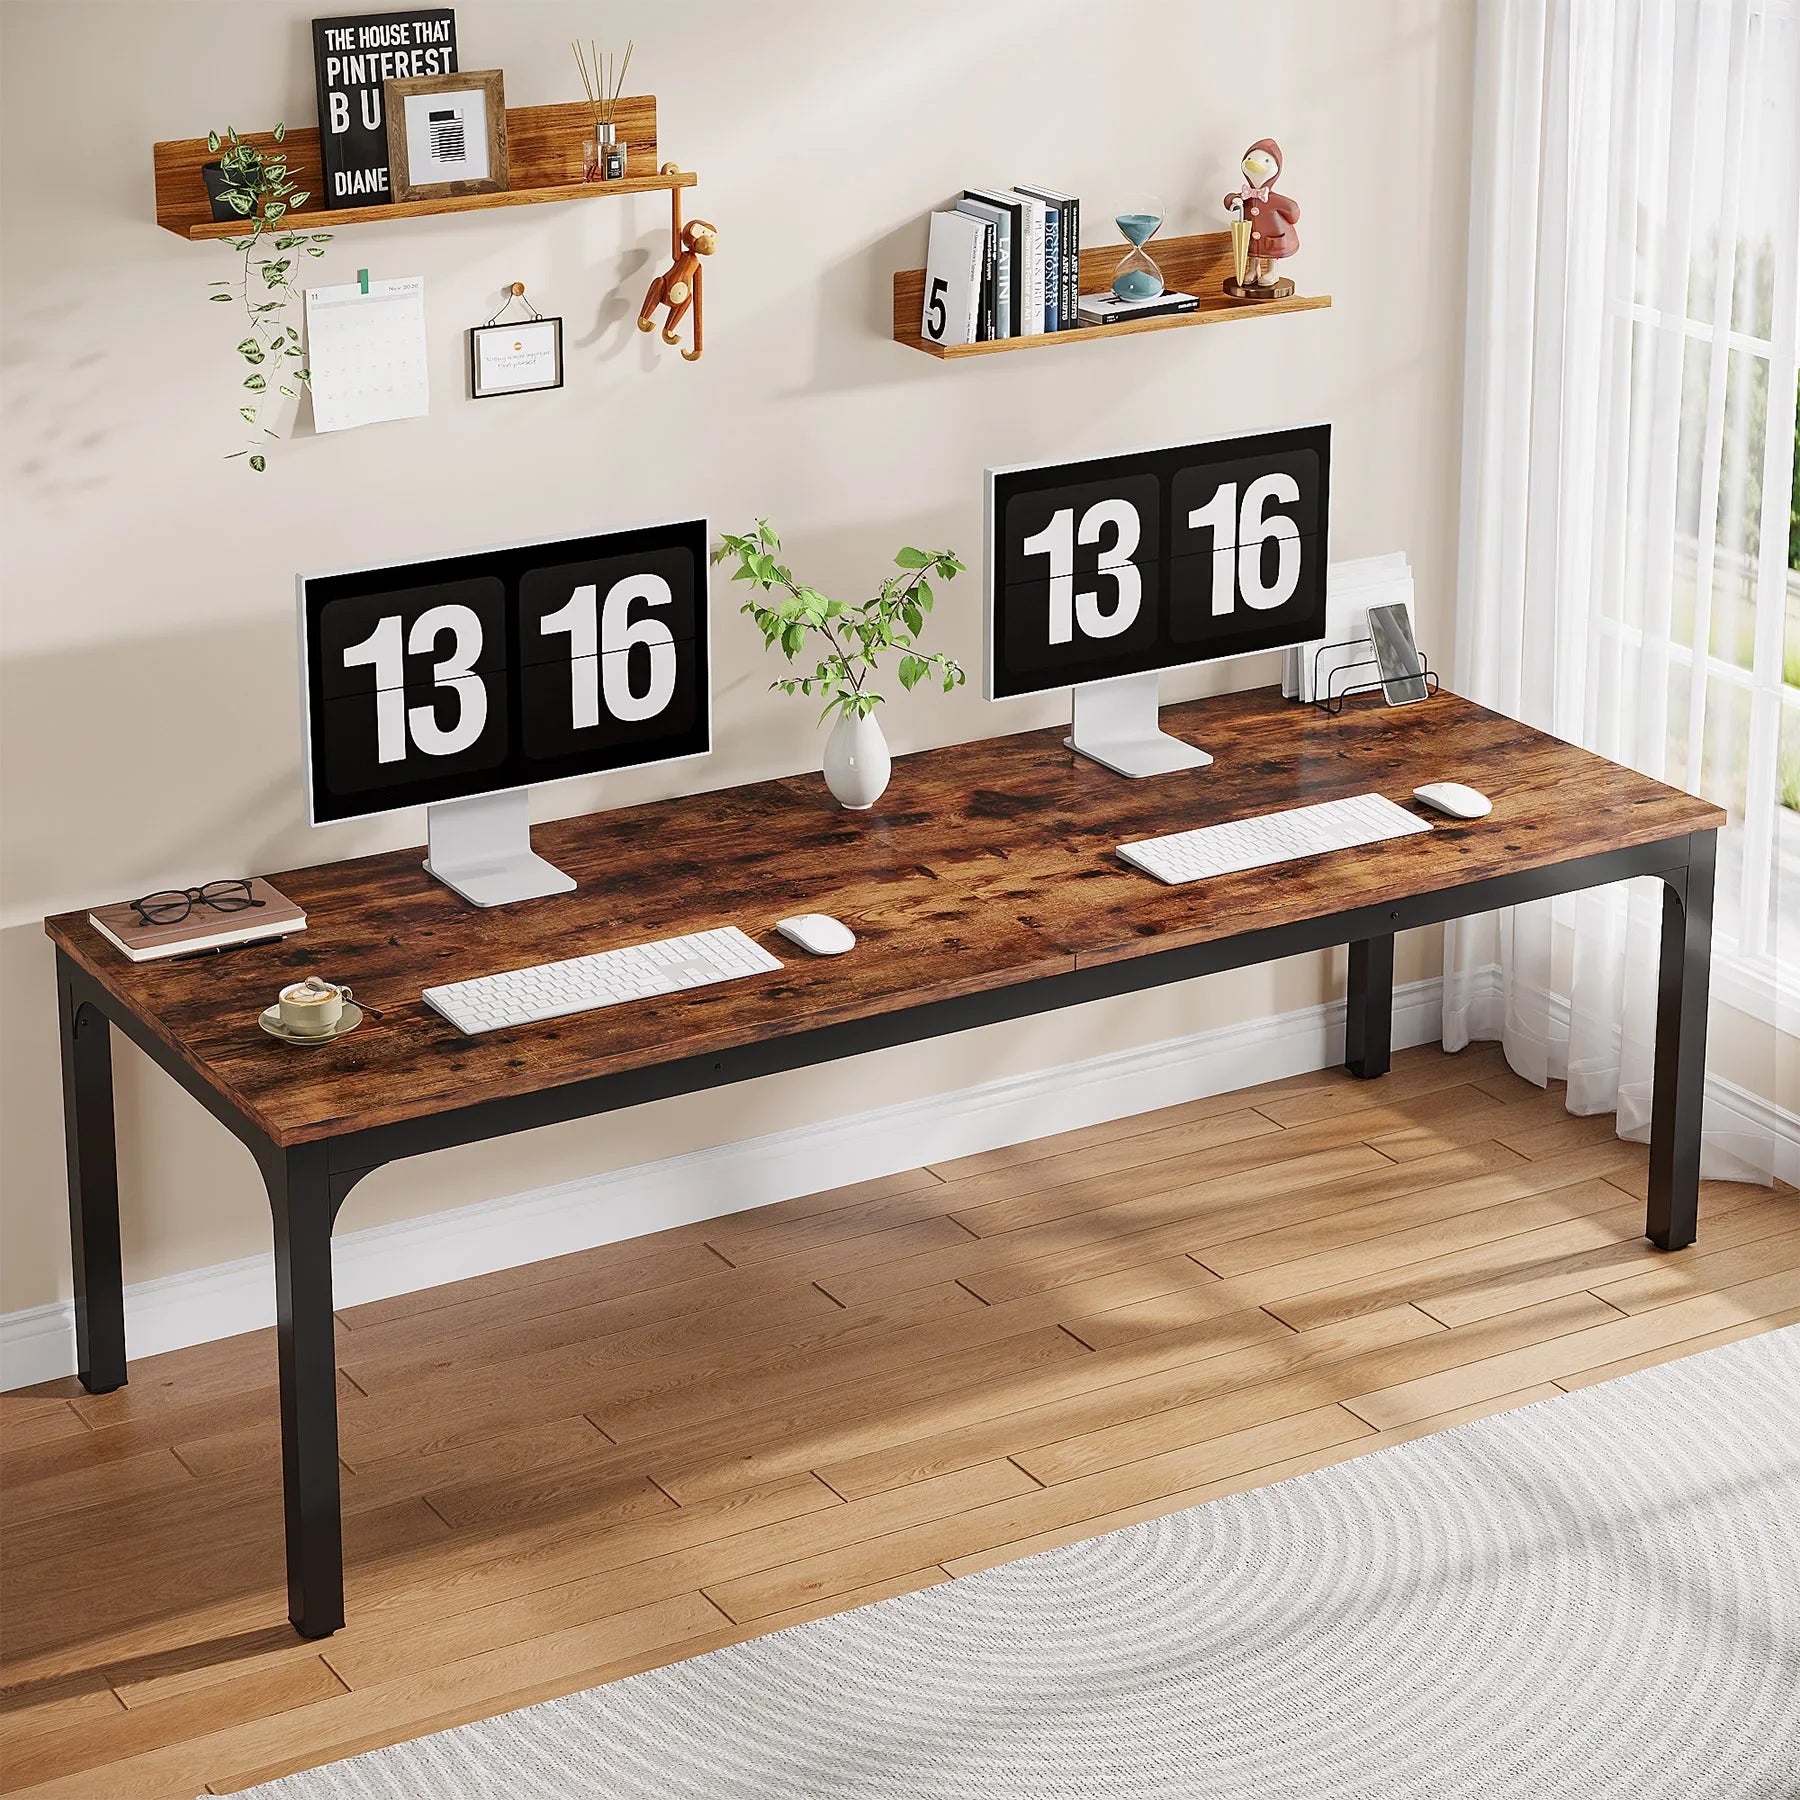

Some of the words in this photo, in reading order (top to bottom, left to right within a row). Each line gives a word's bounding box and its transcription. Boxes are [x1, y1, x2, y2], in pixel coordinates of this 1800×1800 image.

[325, 28, 356, 51] THE
[359, 23, 410, 48] HOUSE
[412, 19, 450, 43] THAT
[326, 46, 453, 87] PINTEREST
[334, 168, 389, 196] DIANE
[1024, 206, 1032, 234] Moving
[1035, 220, 1043, 266] PLANTS
[1045, 222, 1054, 308] DICTIONARY
[1063, 275, 1069, 283] &
[1071, 274, 1077, 282] &
[928, 277, 948, 339] 5
[1025, 296, 1031, 306] on
[1023, 498, 1142, 646] 13
[1188, 472, 1301, 616] 16
[343, 604, 488, 764] 13
[540, 573, 677, 730] 16
